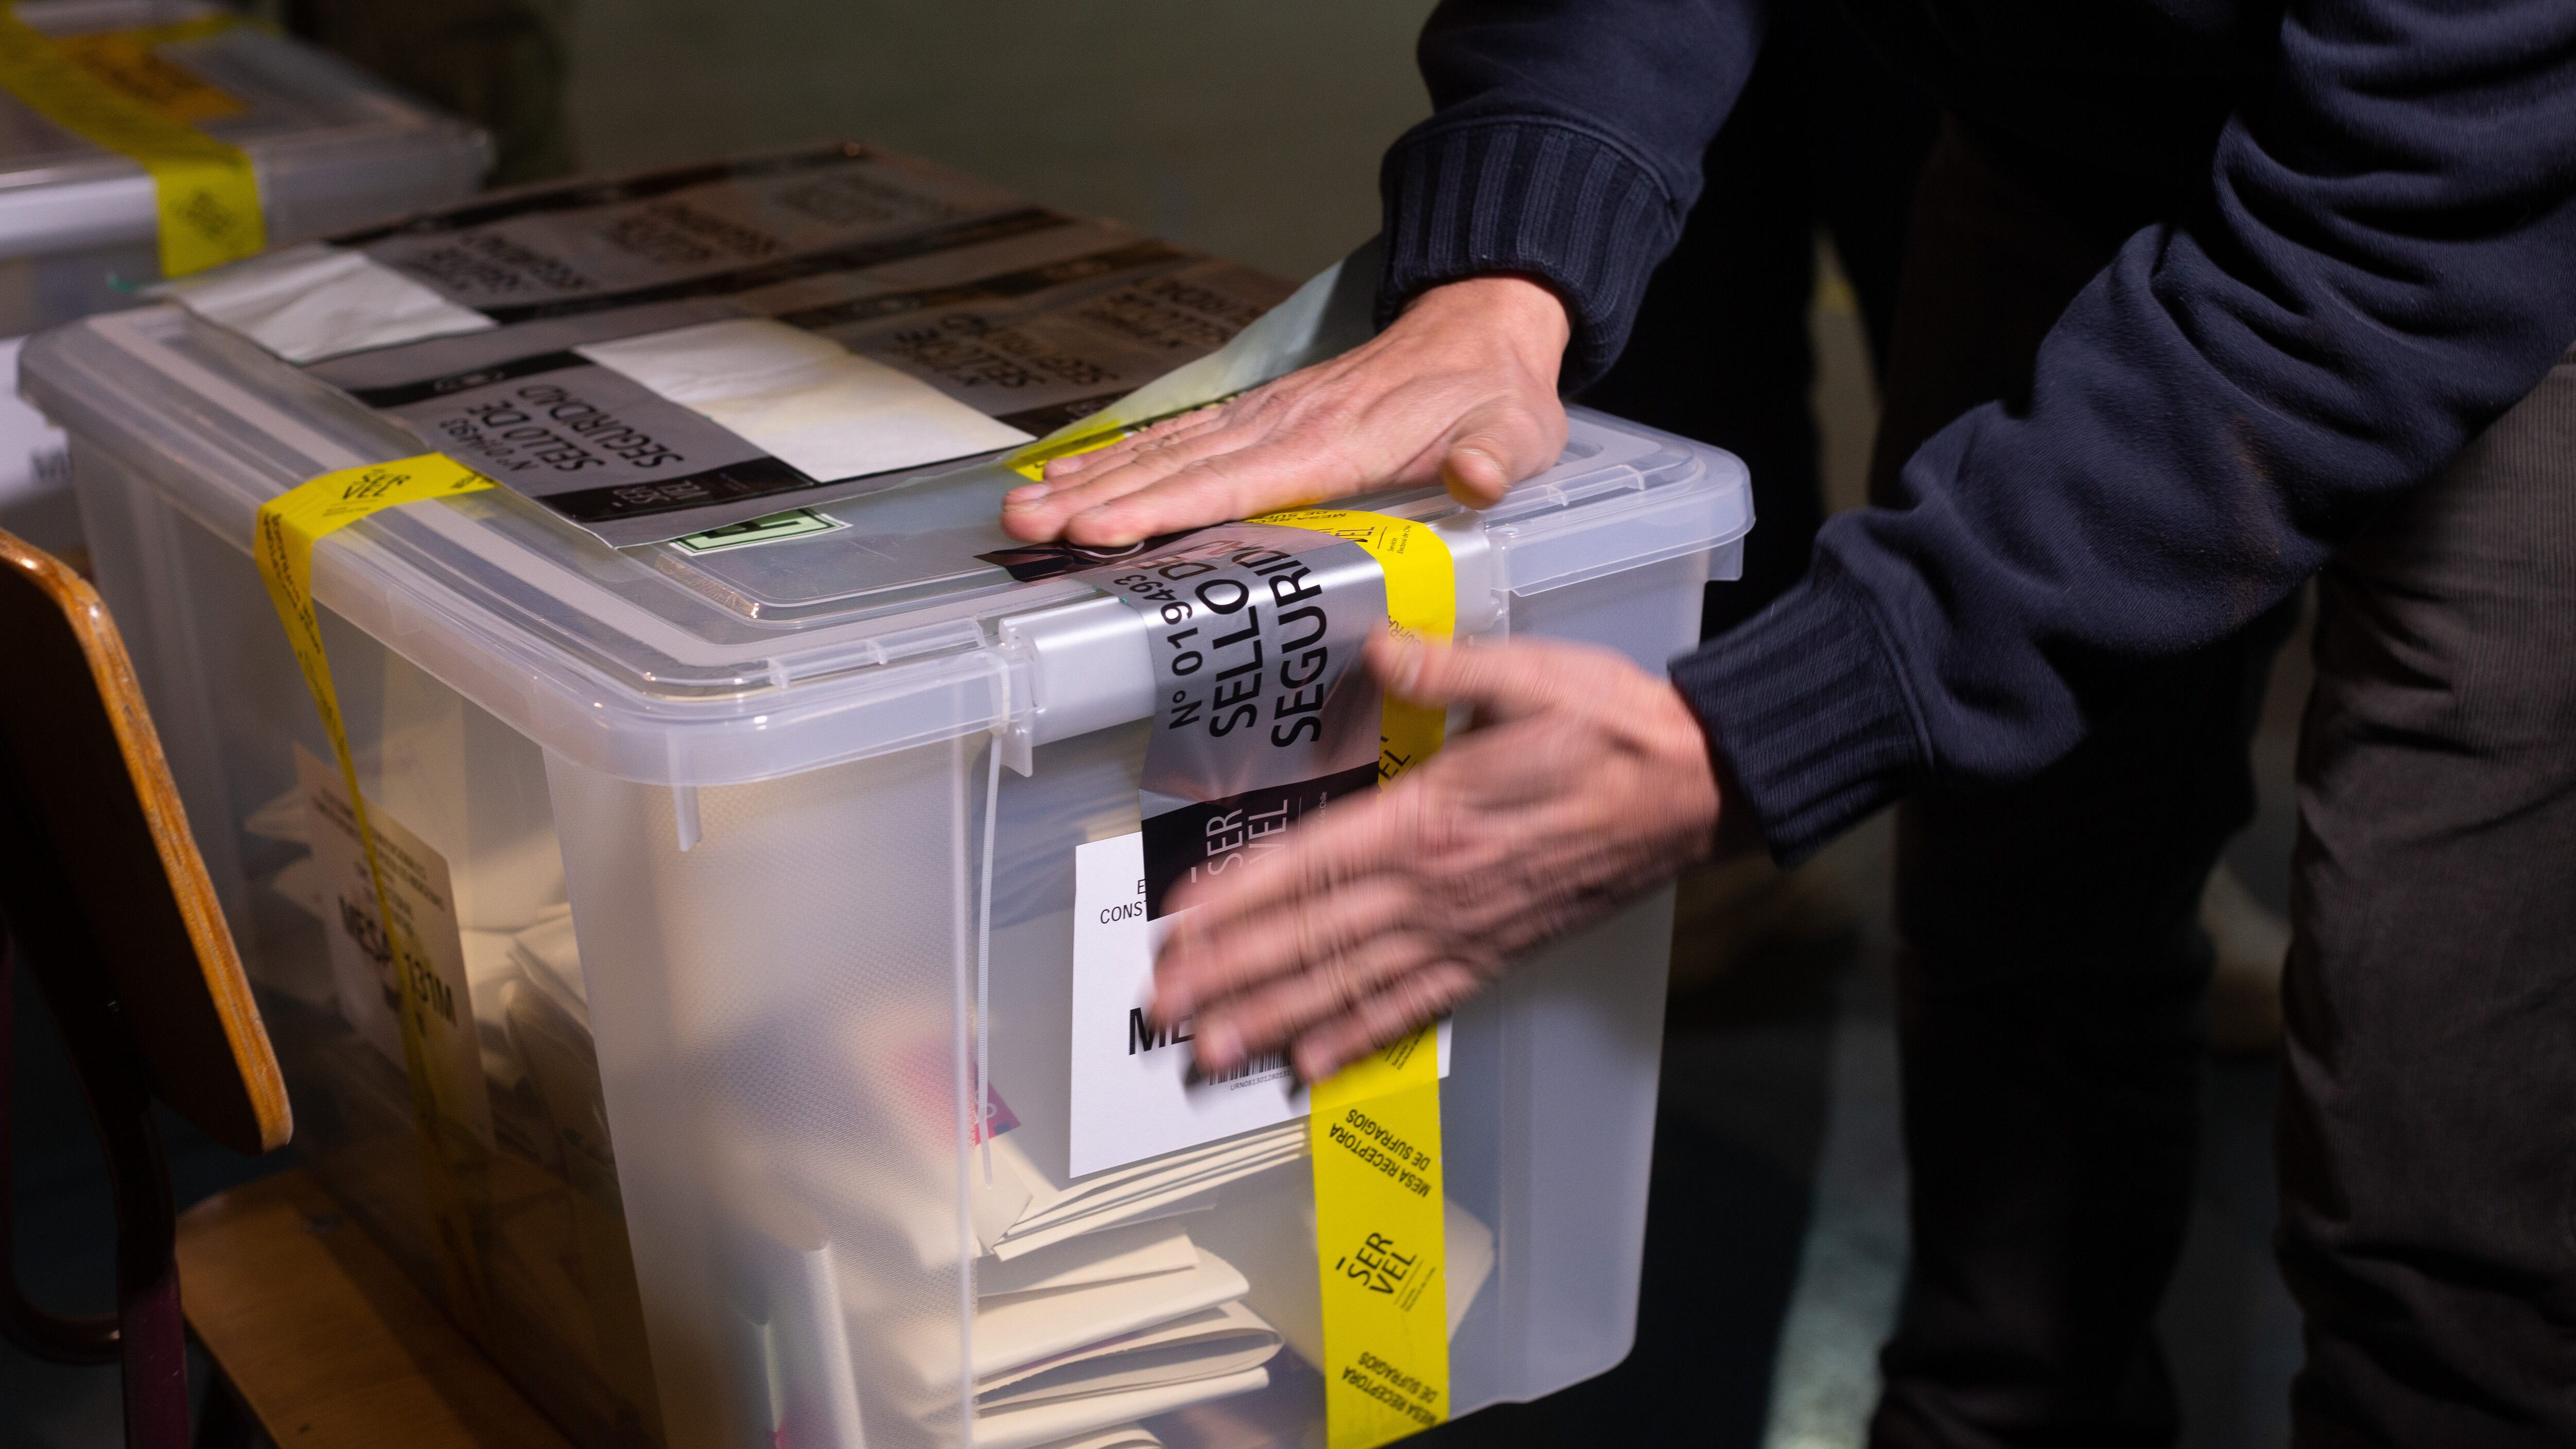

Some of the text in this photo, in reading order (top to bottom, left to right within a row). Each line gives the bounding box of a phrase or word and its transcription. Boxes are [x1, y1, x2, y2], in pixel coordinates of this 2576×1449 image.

[467, 400, 605, 471] SELLO DE
[518, 384, 684, 467] SEGURIDAD
[1113, 574, 1203, 676] 019493
[1195, 579, 1263, 737] SELLO
[1206, 808, 1243, 875] SER
[1248, 799, 1288, 865] VEL
[1100, 900, 1147, 924] CONS
[1329, 1122, 1431, 1198] MESA RECEPTORA
[1346, 1108, 1431, 1171] DE SUFRAGIOS
[1347, 1232, 1394, 1286] SER
[1369, 1251, 1417, 1294] VEL
[1342, 1366, 1407, 1411] RECEPTORA
[1358, 1351, 1422, 1394] SUFRAGIOS
